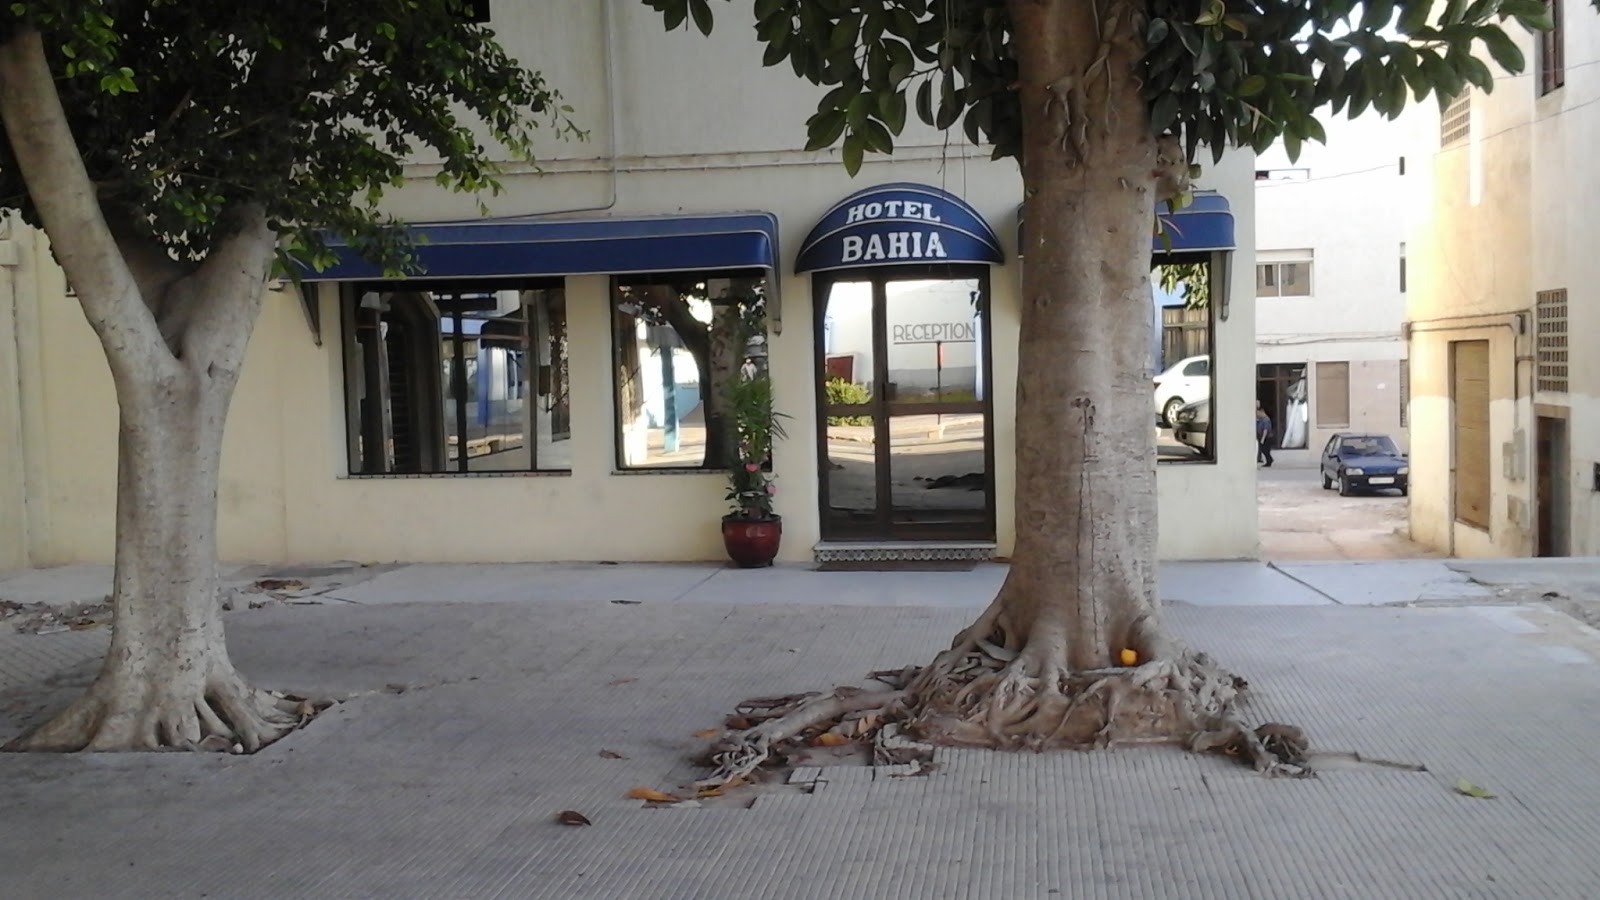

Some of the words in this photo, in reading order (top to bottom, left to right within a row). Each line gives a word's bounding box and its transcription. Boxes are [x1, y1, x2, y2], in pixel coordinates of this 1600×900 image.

[846, 201, 941, 224] HOTEL
[842, 232, 947, 262] BAHIA
[893, 323, 976, 341] RECEPTION
